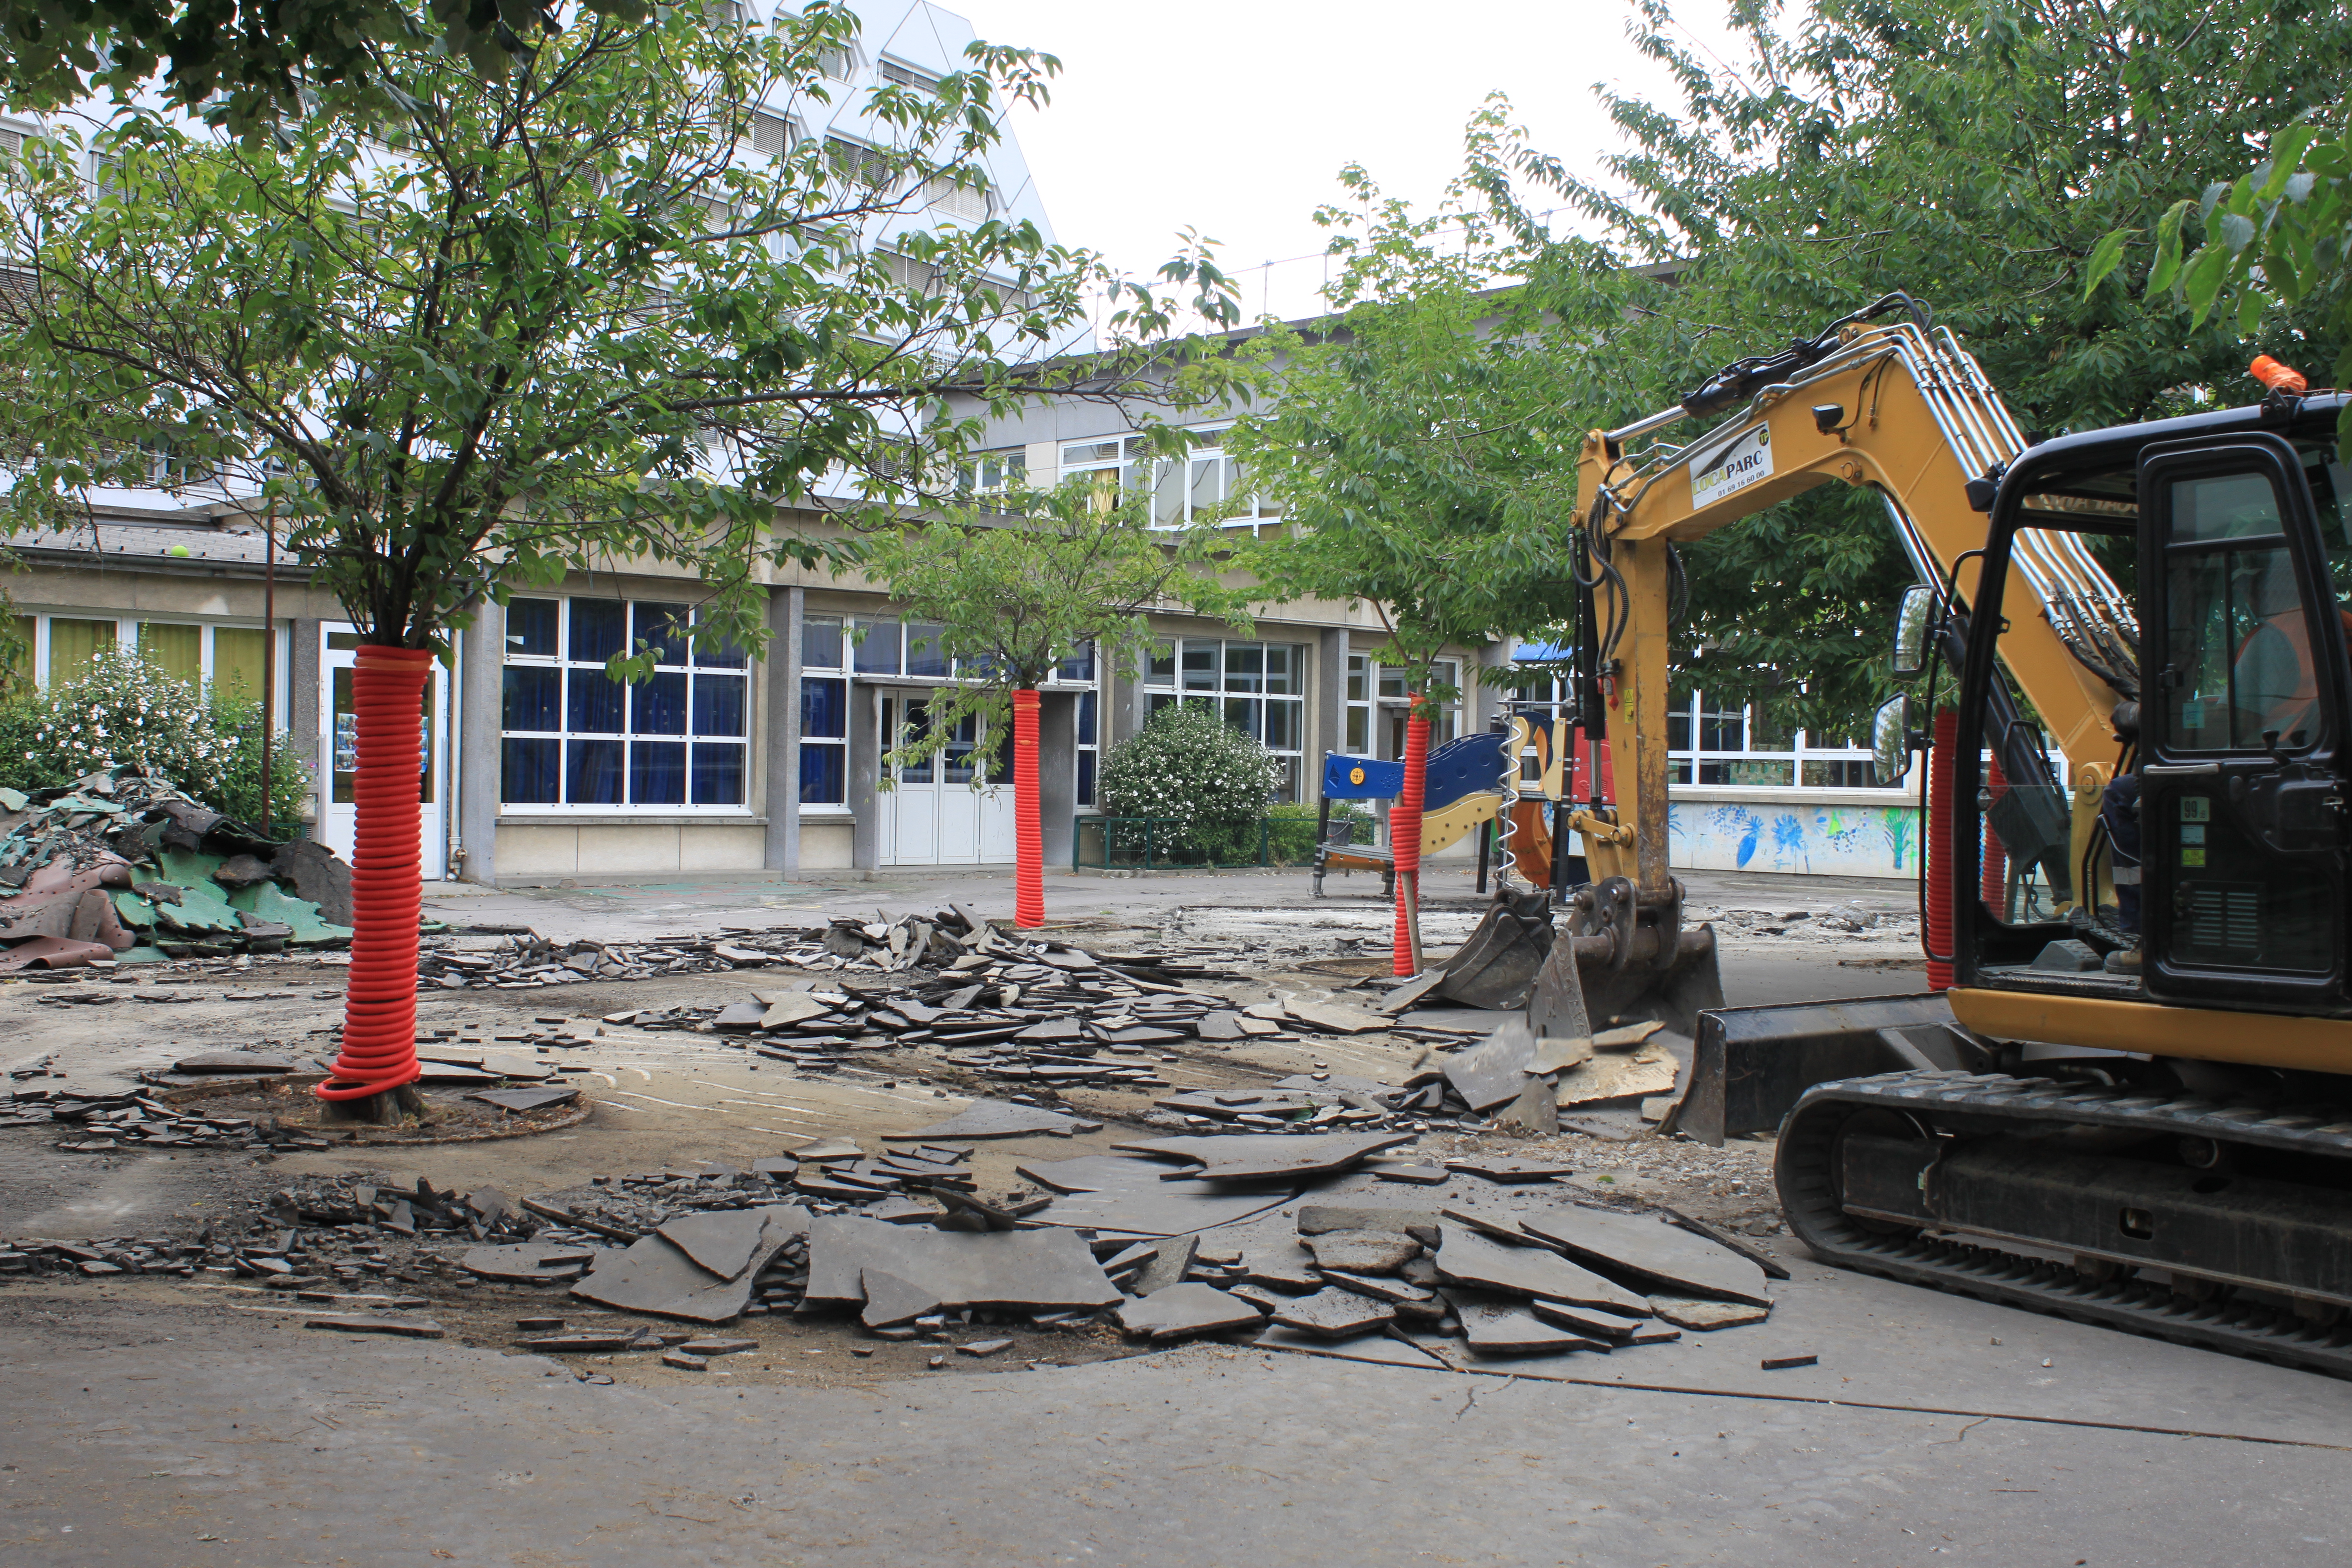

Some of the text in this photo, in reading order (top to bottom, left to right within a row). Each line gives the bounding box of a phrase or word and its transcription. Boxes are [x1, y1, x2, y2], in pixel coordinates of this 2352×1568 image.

[1759, 432, 1769, 444] TP
[1692, 450, 1763, 495] LOCAPARC
[1727, 484, 1735, 492] 69
[1737, 479, 1745, 488] 16
[1747, 474, 1755, 483] 60
[1756, 470, 1764, 479] 00
[2185, 800, 2197, 818] 99
